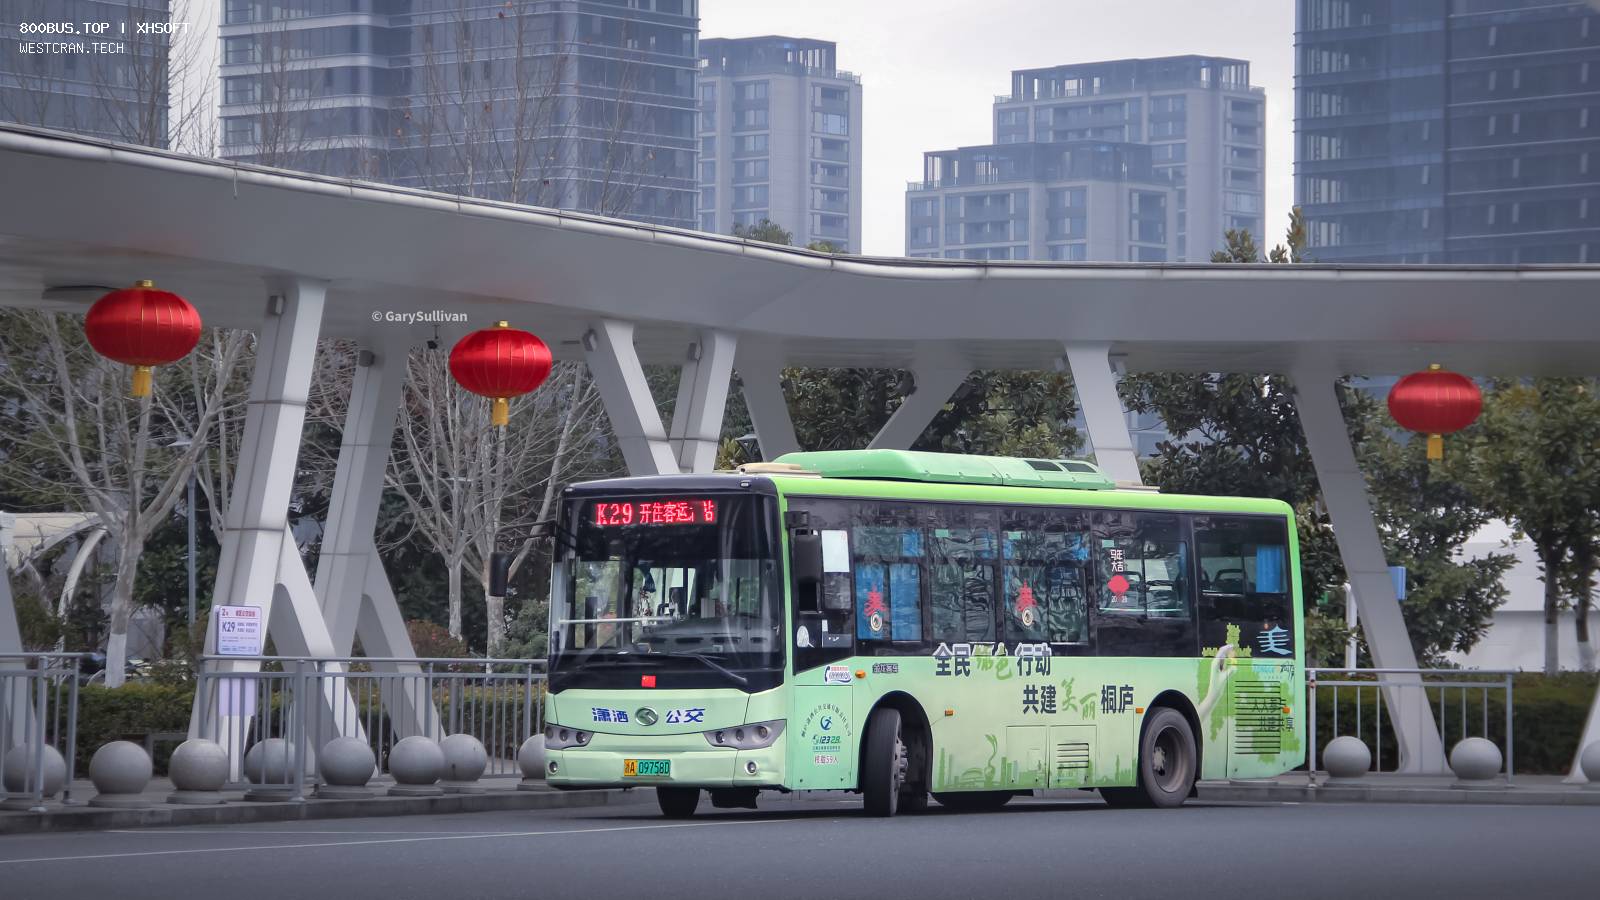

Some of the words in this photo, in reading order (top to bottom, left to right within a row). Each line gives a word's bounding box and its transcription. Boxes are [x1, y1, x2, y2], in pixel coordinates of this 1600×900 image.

[596, 503, 632, 525] K29
[222, 621, 236, 633] K29
[1022, 677, 1134, 721] 共建美丽桐庐
[591, 706, 629, 723] 潇洒
[666, 708, 706, 724] 公交
